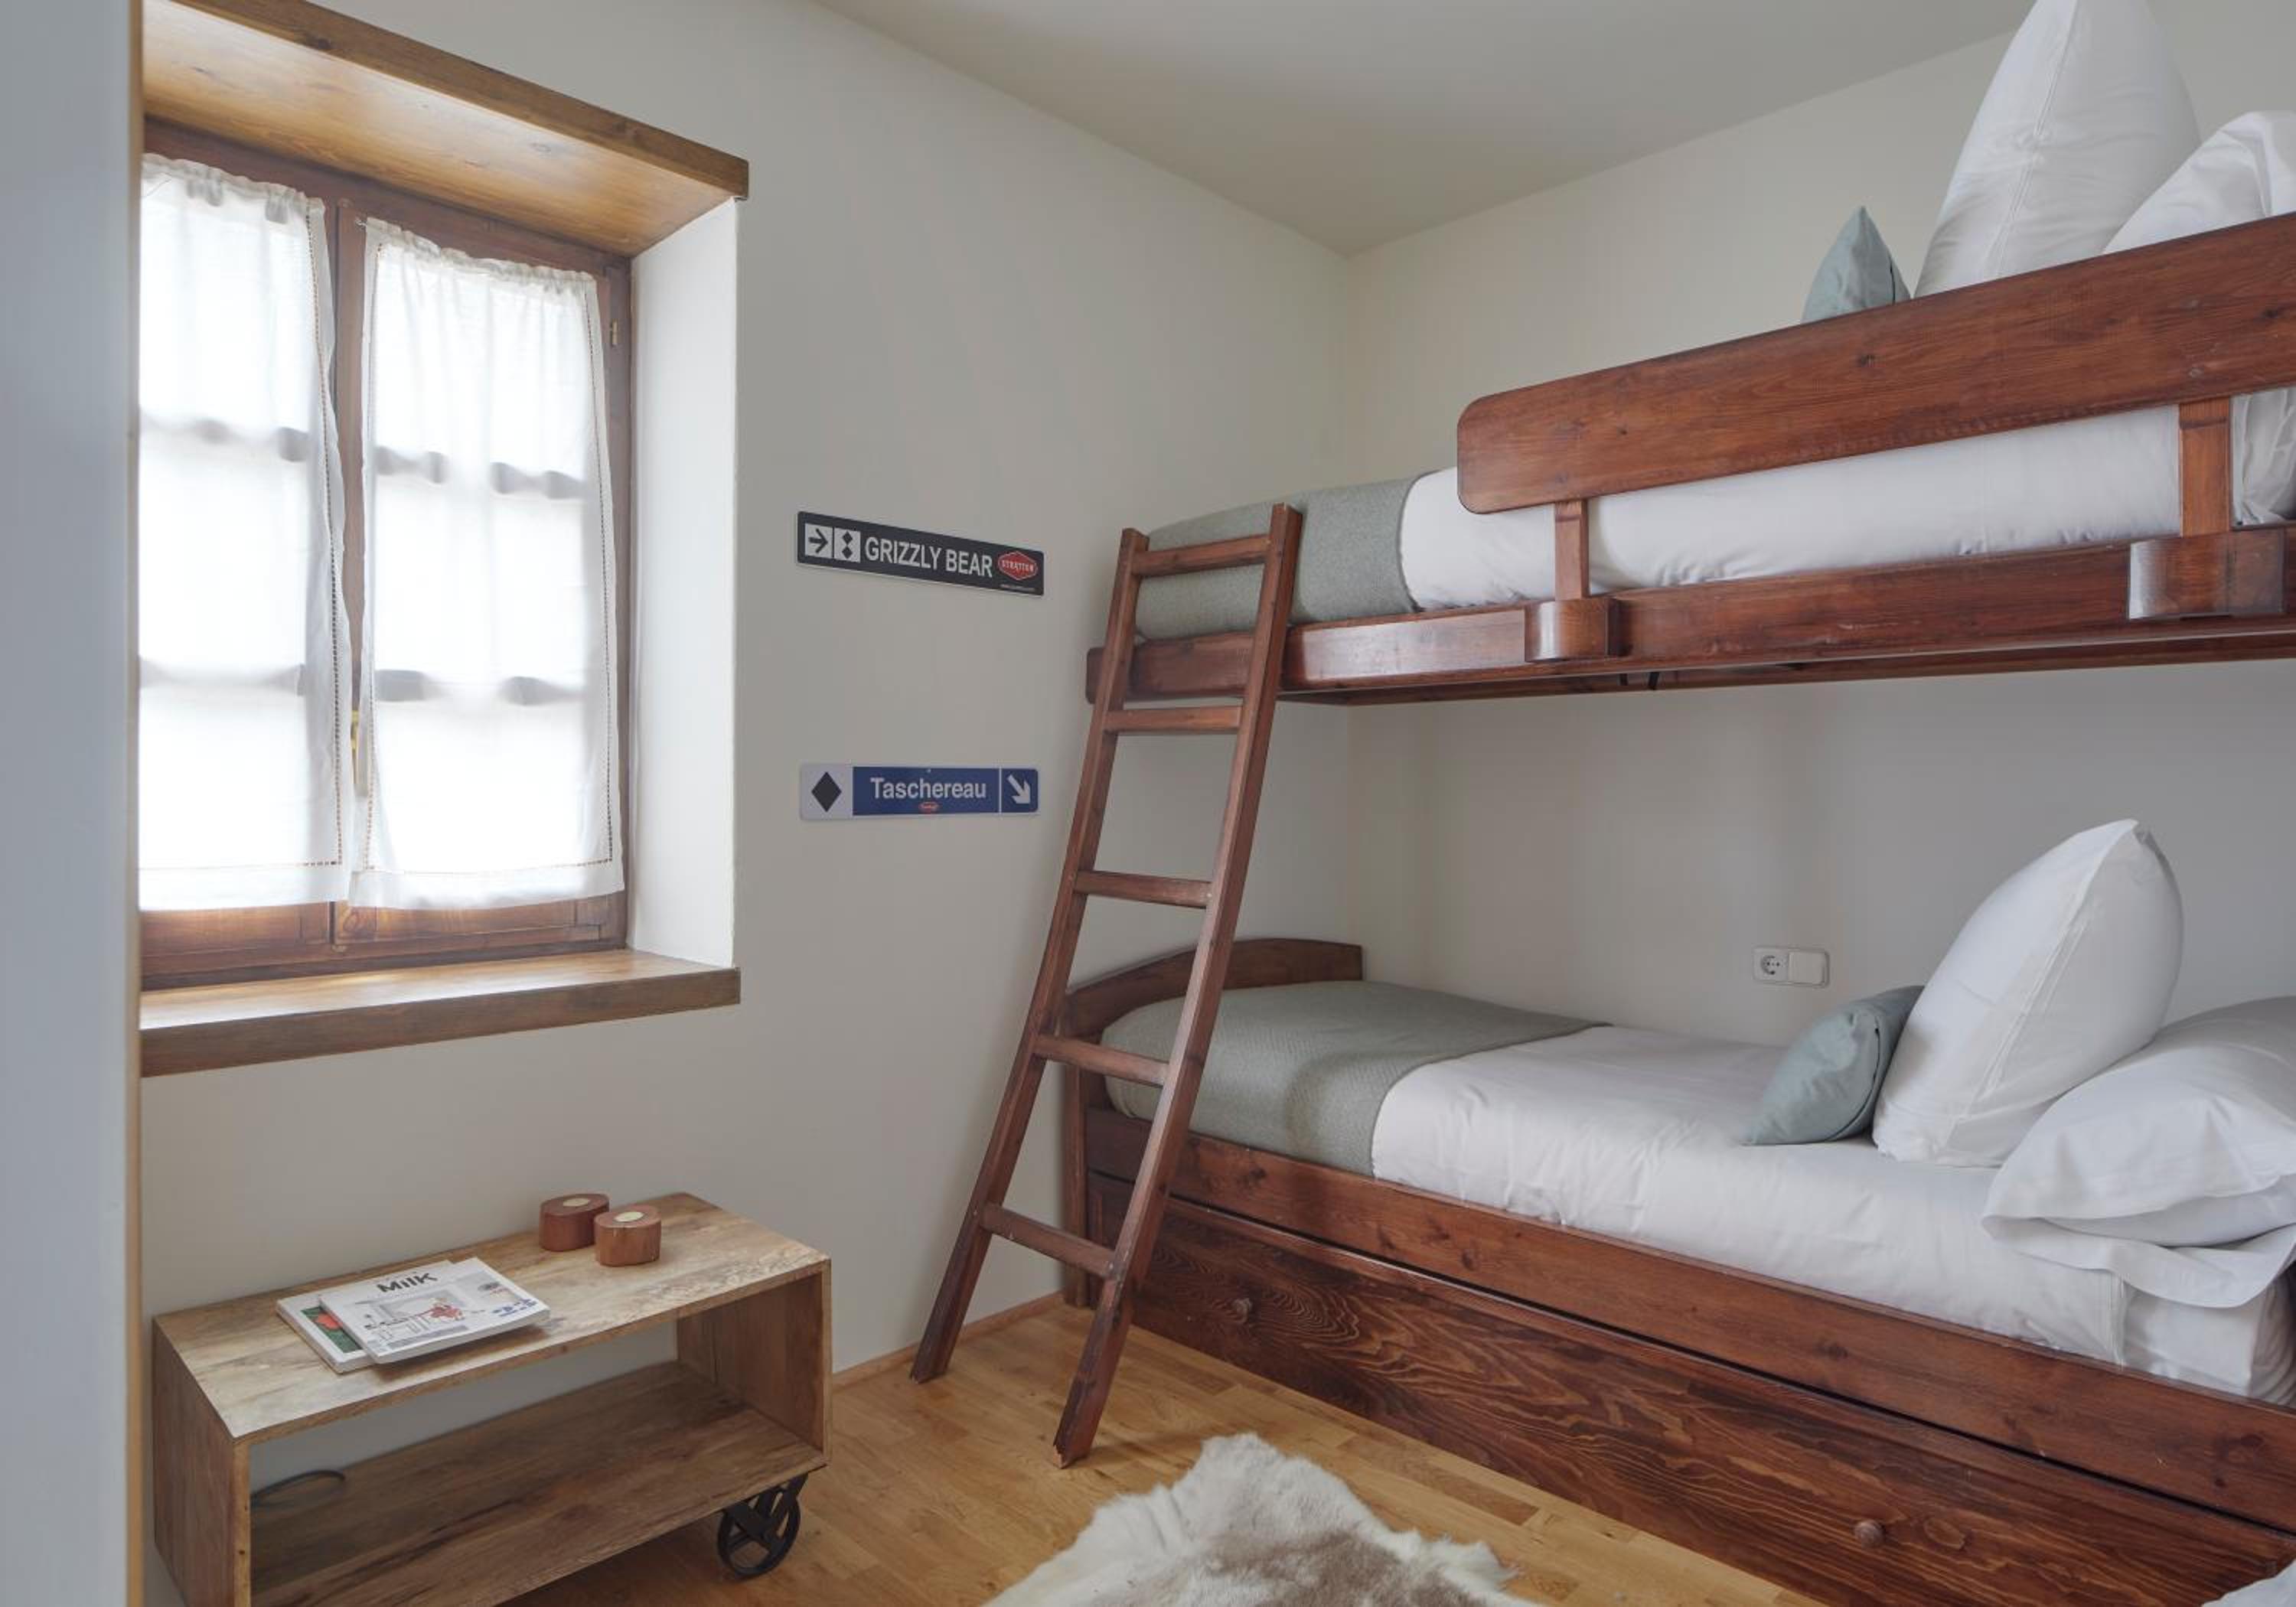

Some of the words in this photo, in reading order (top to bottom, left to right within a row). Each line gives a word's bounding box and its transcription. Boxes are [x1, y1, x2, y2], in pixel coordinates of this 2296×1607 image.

[865, 536, 942, 569] GRIZZLY
[946, 549, 993, 577] BEAR
[870, 777, 987, 799] Taschereau
